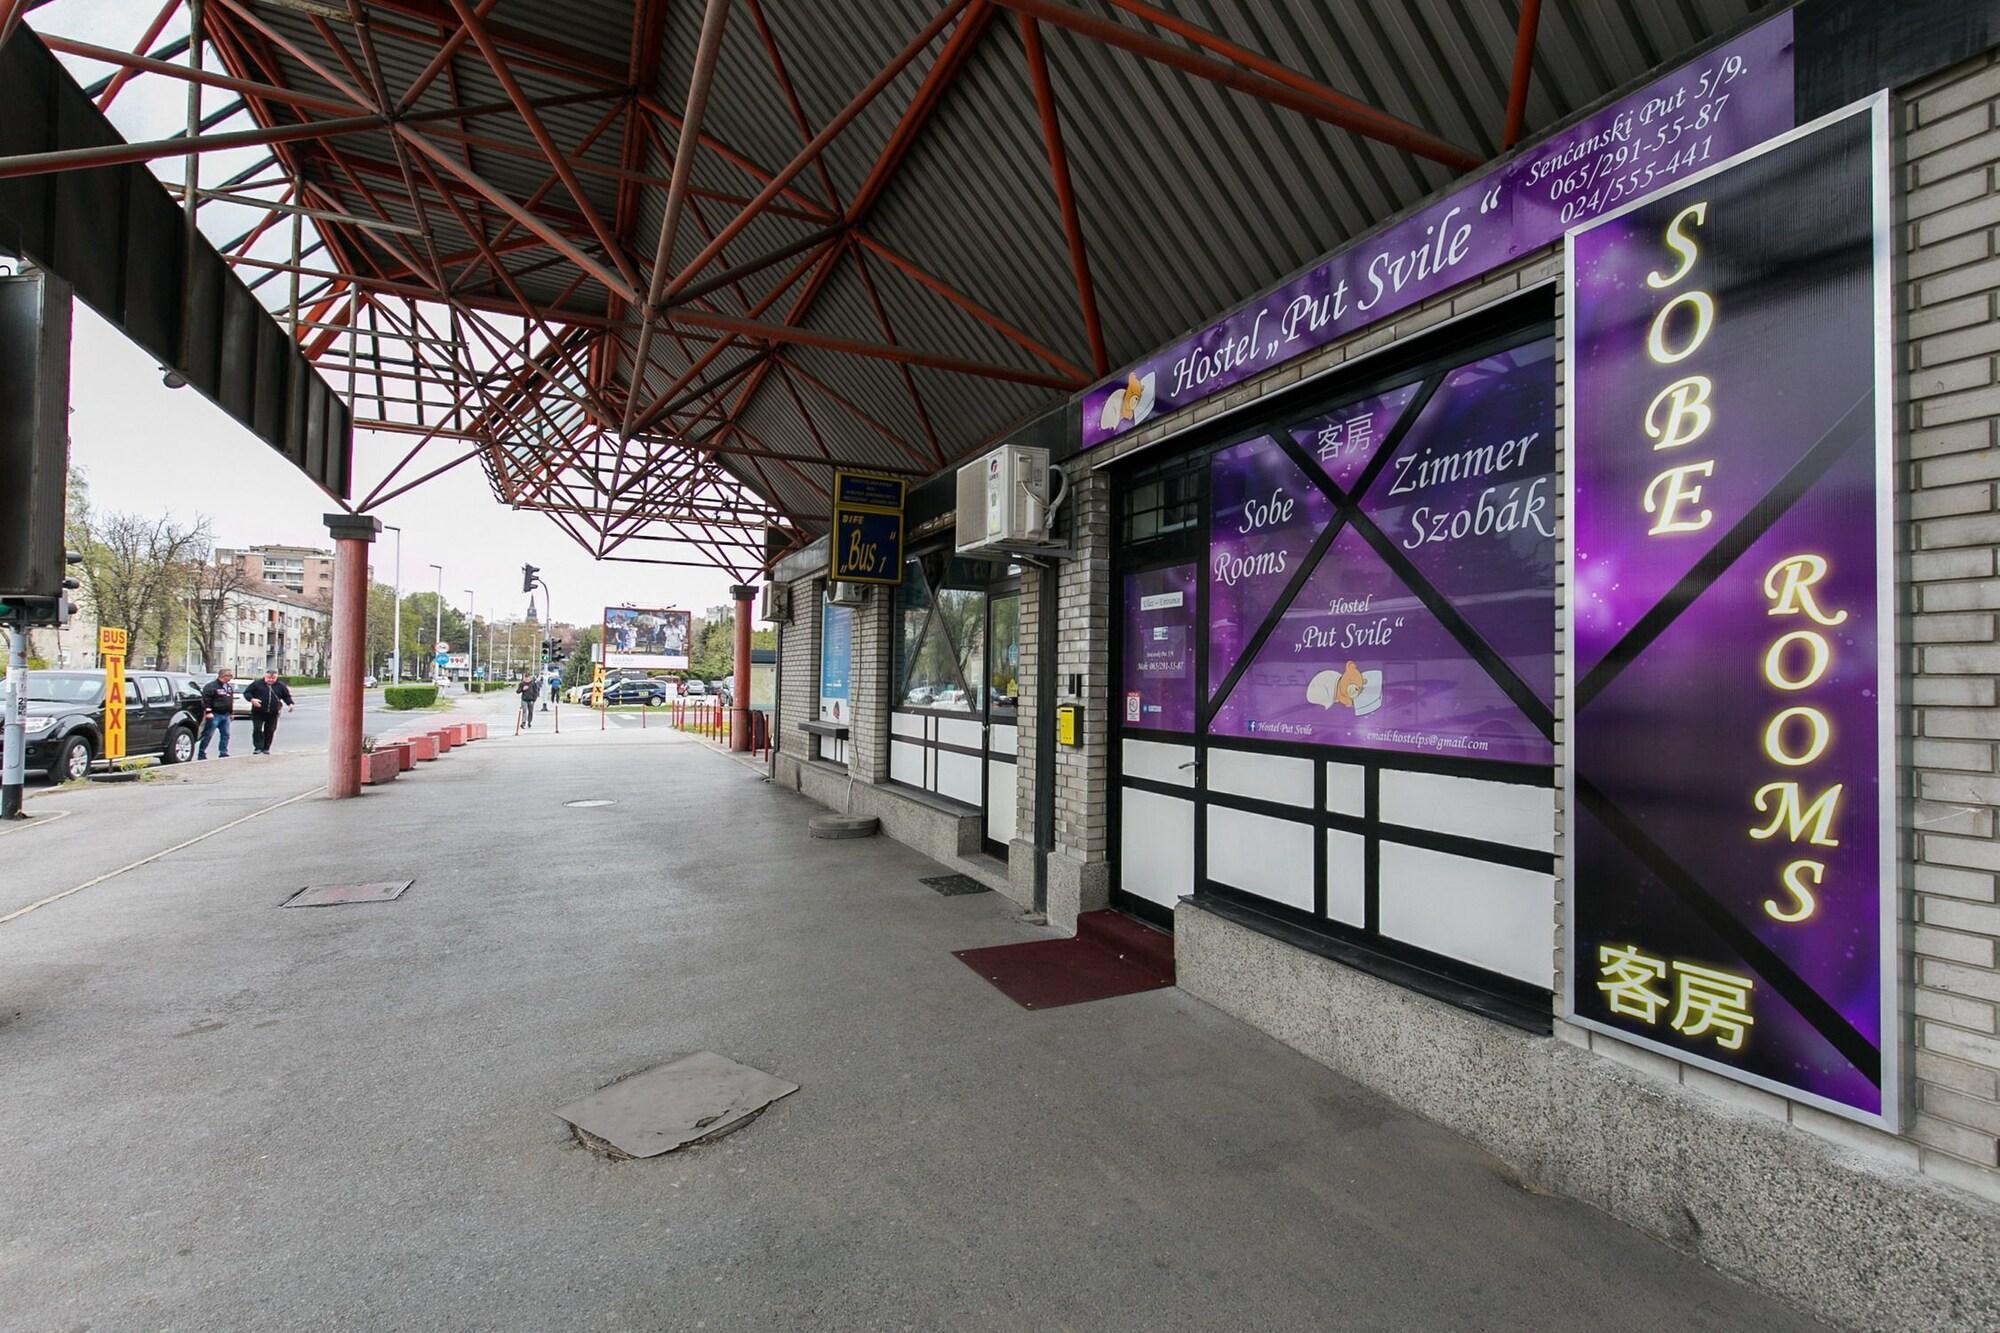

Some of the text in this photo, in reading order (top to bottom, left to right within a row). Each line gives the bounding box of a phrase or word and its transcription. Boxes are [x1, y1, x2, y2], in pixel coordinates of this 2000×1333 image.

[1526, 55, 1748, 186] Senćanski Put 5/9.
[1550, 93, 1729, 200] 065/291-55-87
[1560, 135, 1713, 224] 024/555-441
[1171, 308, 1269, 398] Hostel
[1643, 201, 1715, 537] SOBE
[1316, 412, 1374, 463] 客房
[1388, 432, 1540, 497] Zimmer
[1239, 487, 1294, 534] Sobe
[1403, 477, 1556, 550] Szobák
[1213, 549, 1288, 587] Rooms
[103, 630, 125, 644] BUS
[1328, 594, 1374, 616] Hostel
[110, 656, 122, 755] TAXI
[595, 667, 603, 702] TAXI
[1258, 721, 1280, 733] Hostel
[1280, 723, 1294, 735] Put
[1295, 724, 1313, 736] Svile
[1366, 729, 1490, 752] email:hostelps@gmail.com
[1749, 554, 1847, 923] ROOMS
[1597, 944, 1755, 1050] 客房
